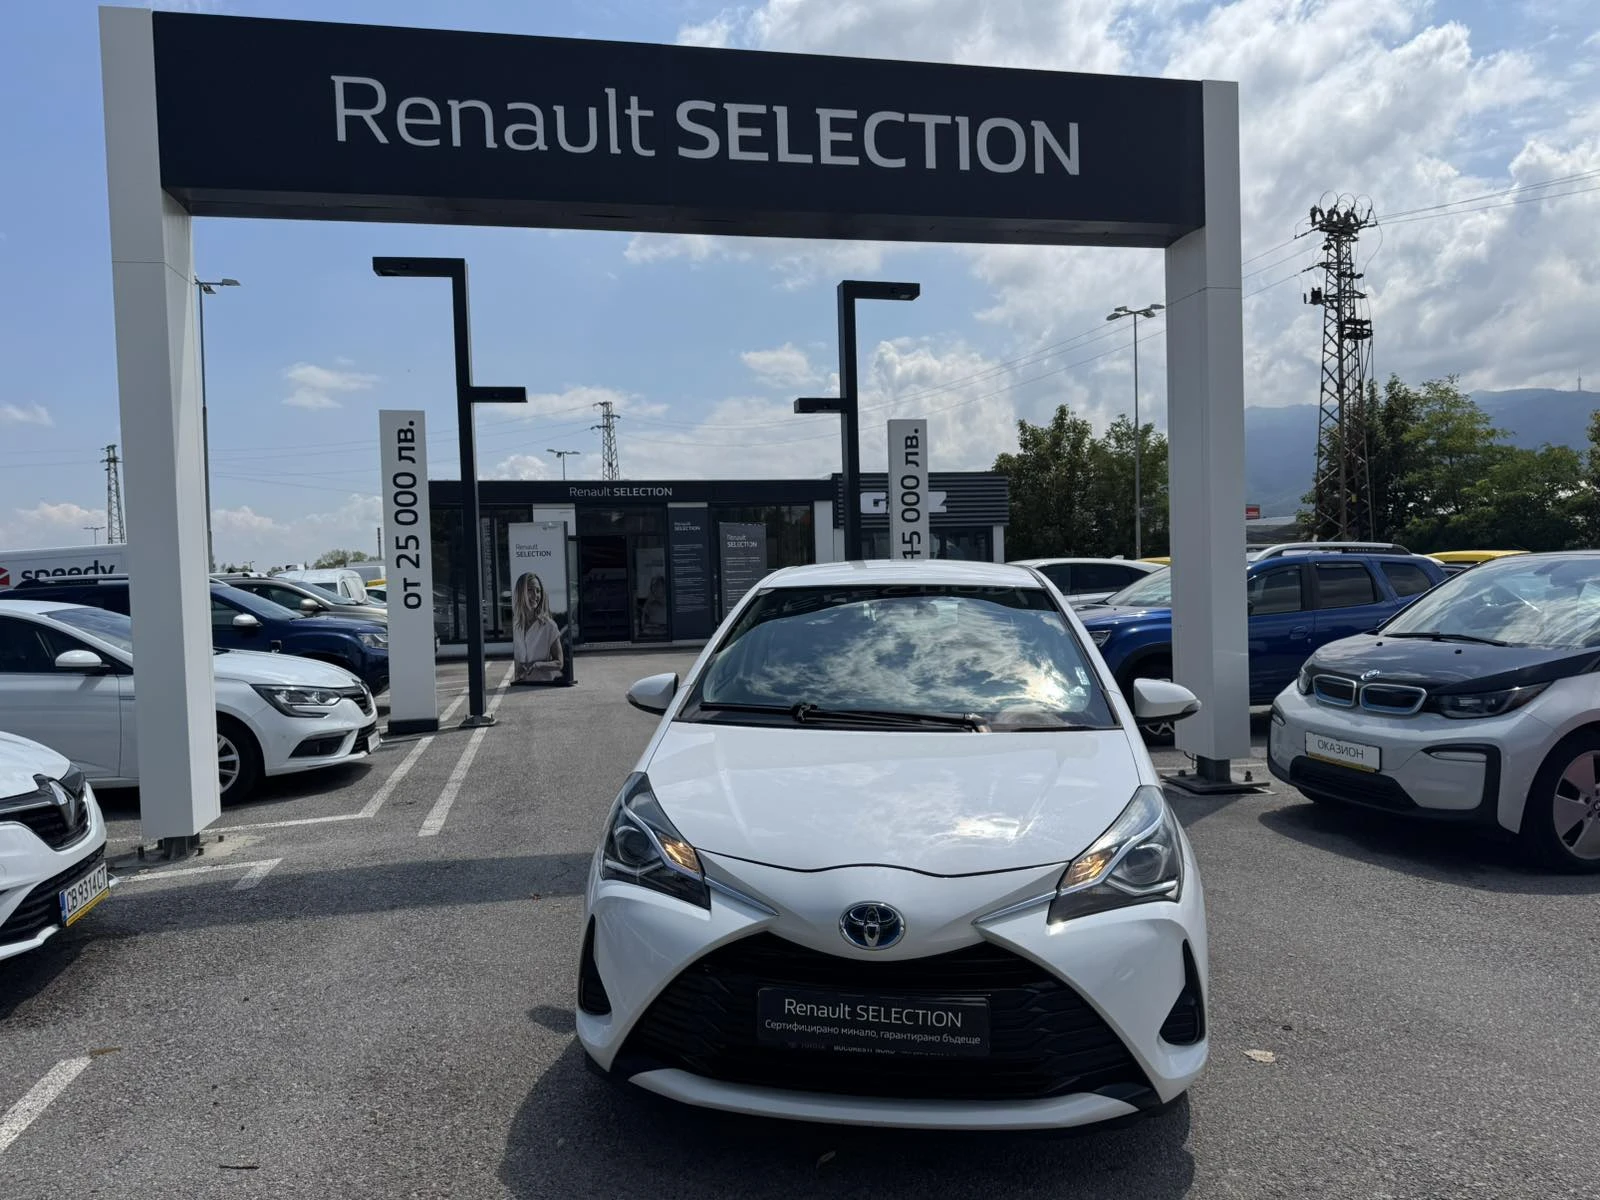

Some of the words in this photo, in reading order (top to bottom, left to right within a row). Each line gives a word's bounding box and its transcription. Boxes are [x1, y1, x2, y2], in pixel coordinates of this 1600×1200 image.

[331, 76, 655, 157] Renault
[677, 100, 1080, 176] SELECTION
[397, 421, 416, 463] лв.
[904, 428, 919, 467] лв.
[393, 472, 418, 525] 000
[569, 487, 611, 497] Renault
[613, 487, 673, 497] SELECTION
[901, 475, 920, 523] 000
[396, 535, 420, 568] 25
[516, 550, 552, 558] SELECTION
[902, 531, 921, 559] 15
[1317, 739, 1364, 760] ОКАЗИОН
[785, 998, 851, 1020] Renault
[856, 1004, 962, 1028] SELECTION
[765, 1019, 840, 1035] Сертифицирано
[880, 1031, 941, 1042] гарантирано
[942, 1033, 981, 1046] бъдеще
